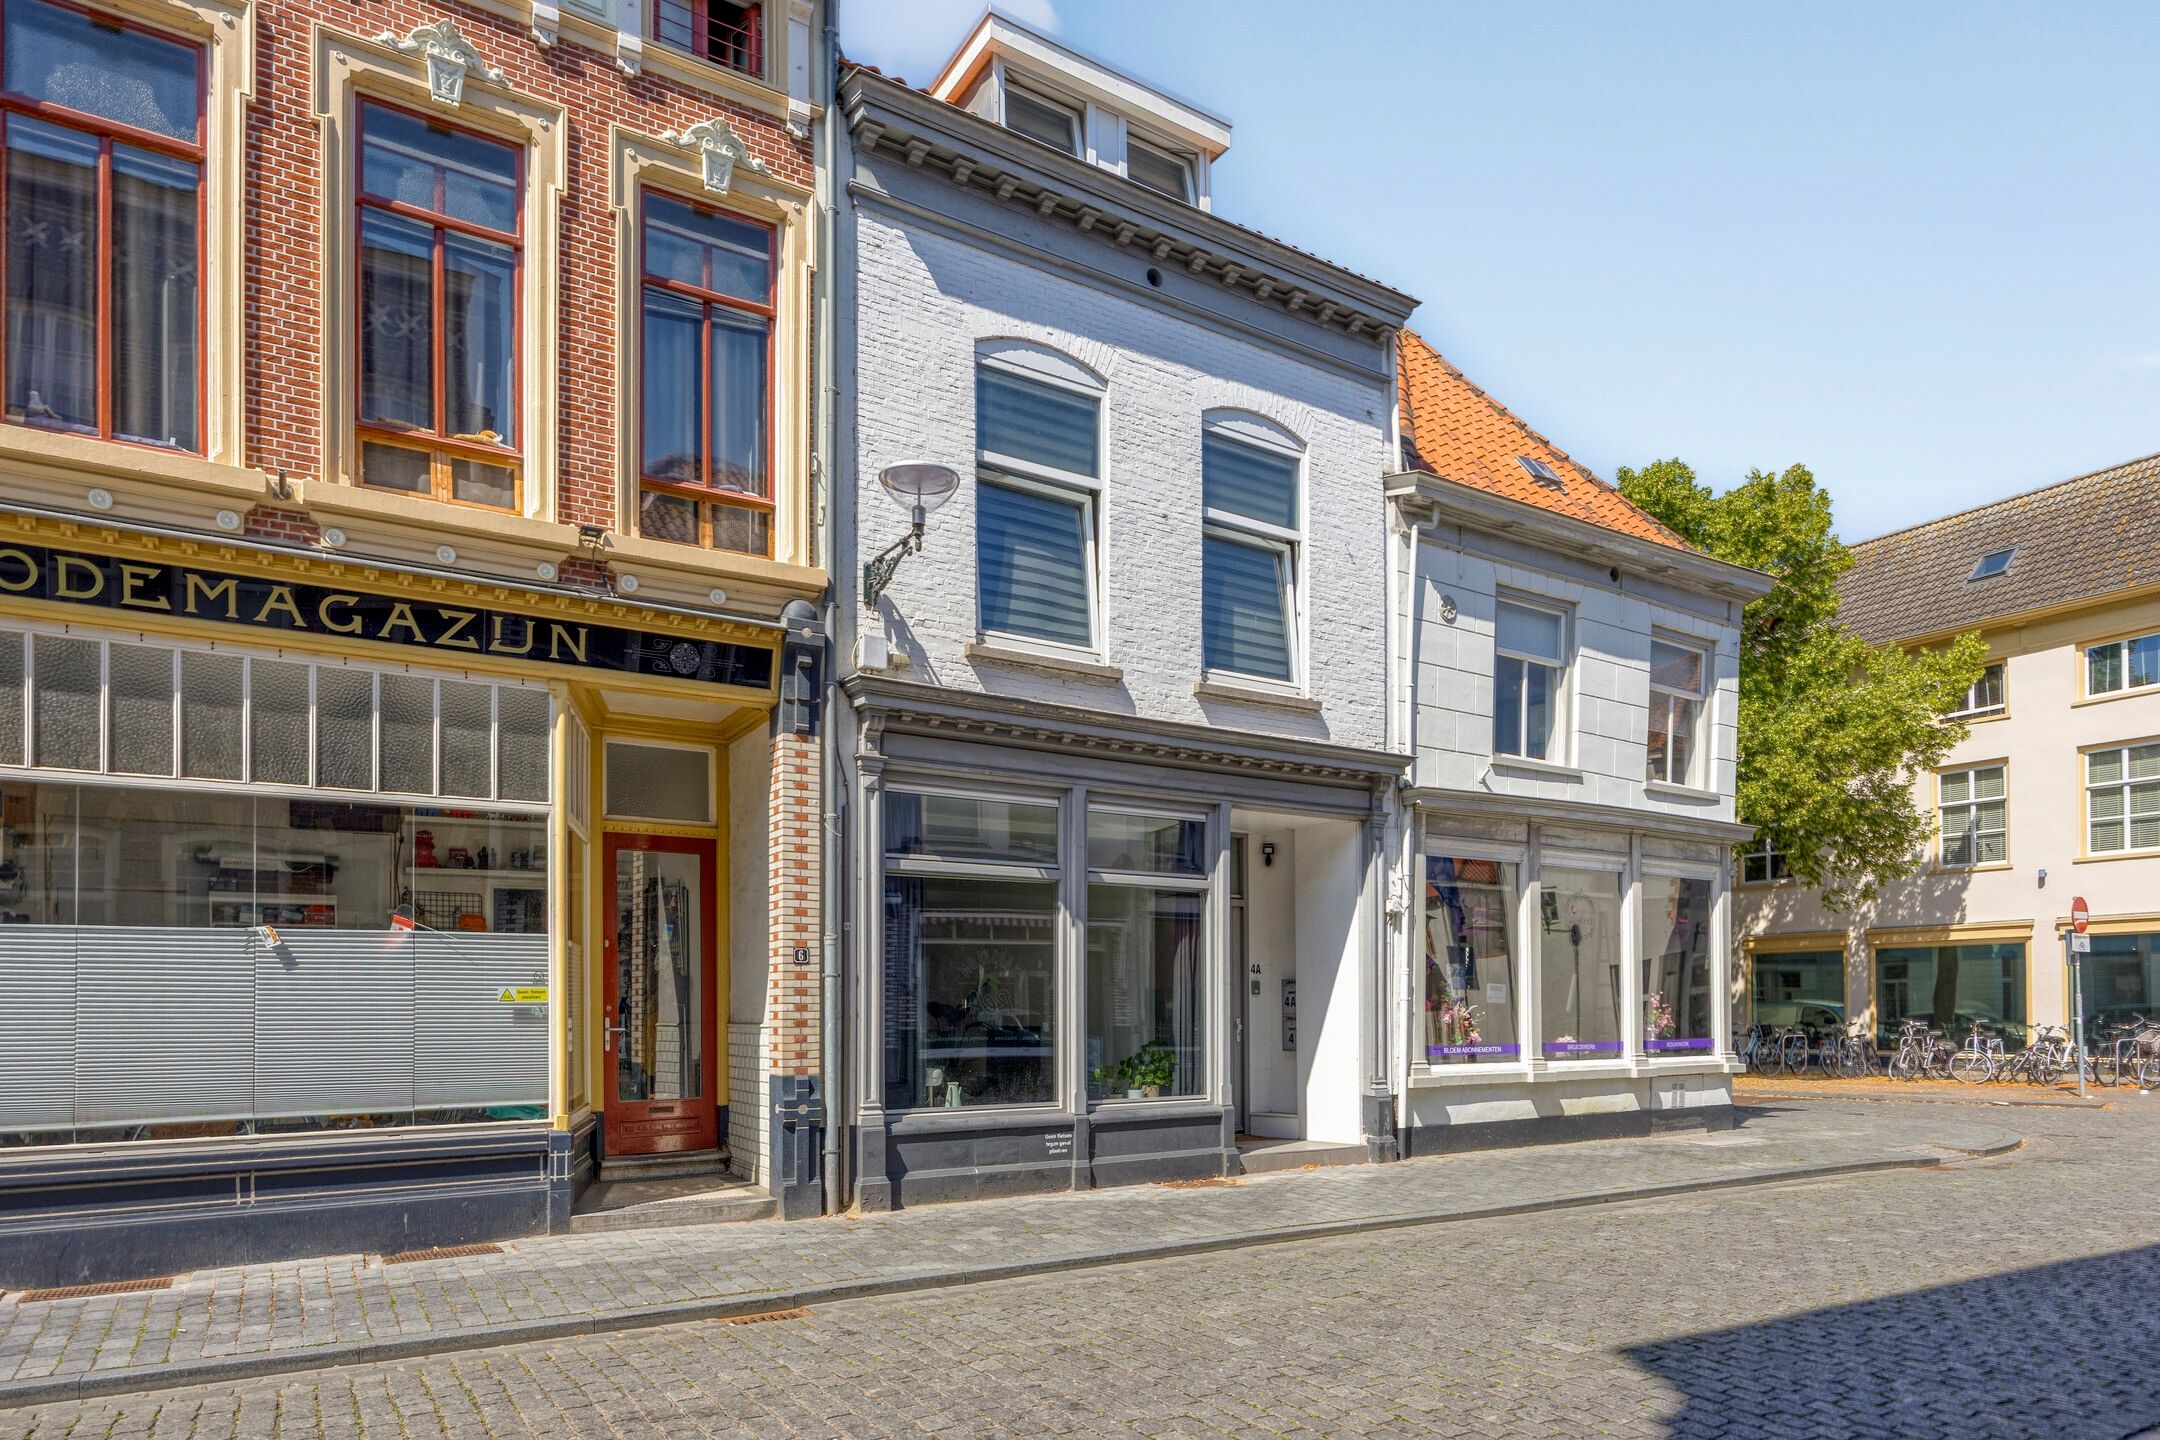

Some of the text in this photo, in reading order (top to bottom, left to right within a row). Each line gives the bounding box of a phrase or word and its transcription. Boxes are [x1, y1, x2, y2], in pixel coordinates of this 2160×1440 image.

[798, 950, 804, 961] 6
[1250, 963, 1261, 975] 4A
[1284, 996, 1296, 1008] 4A
[1288, 1033, 1295, 1044] 4
